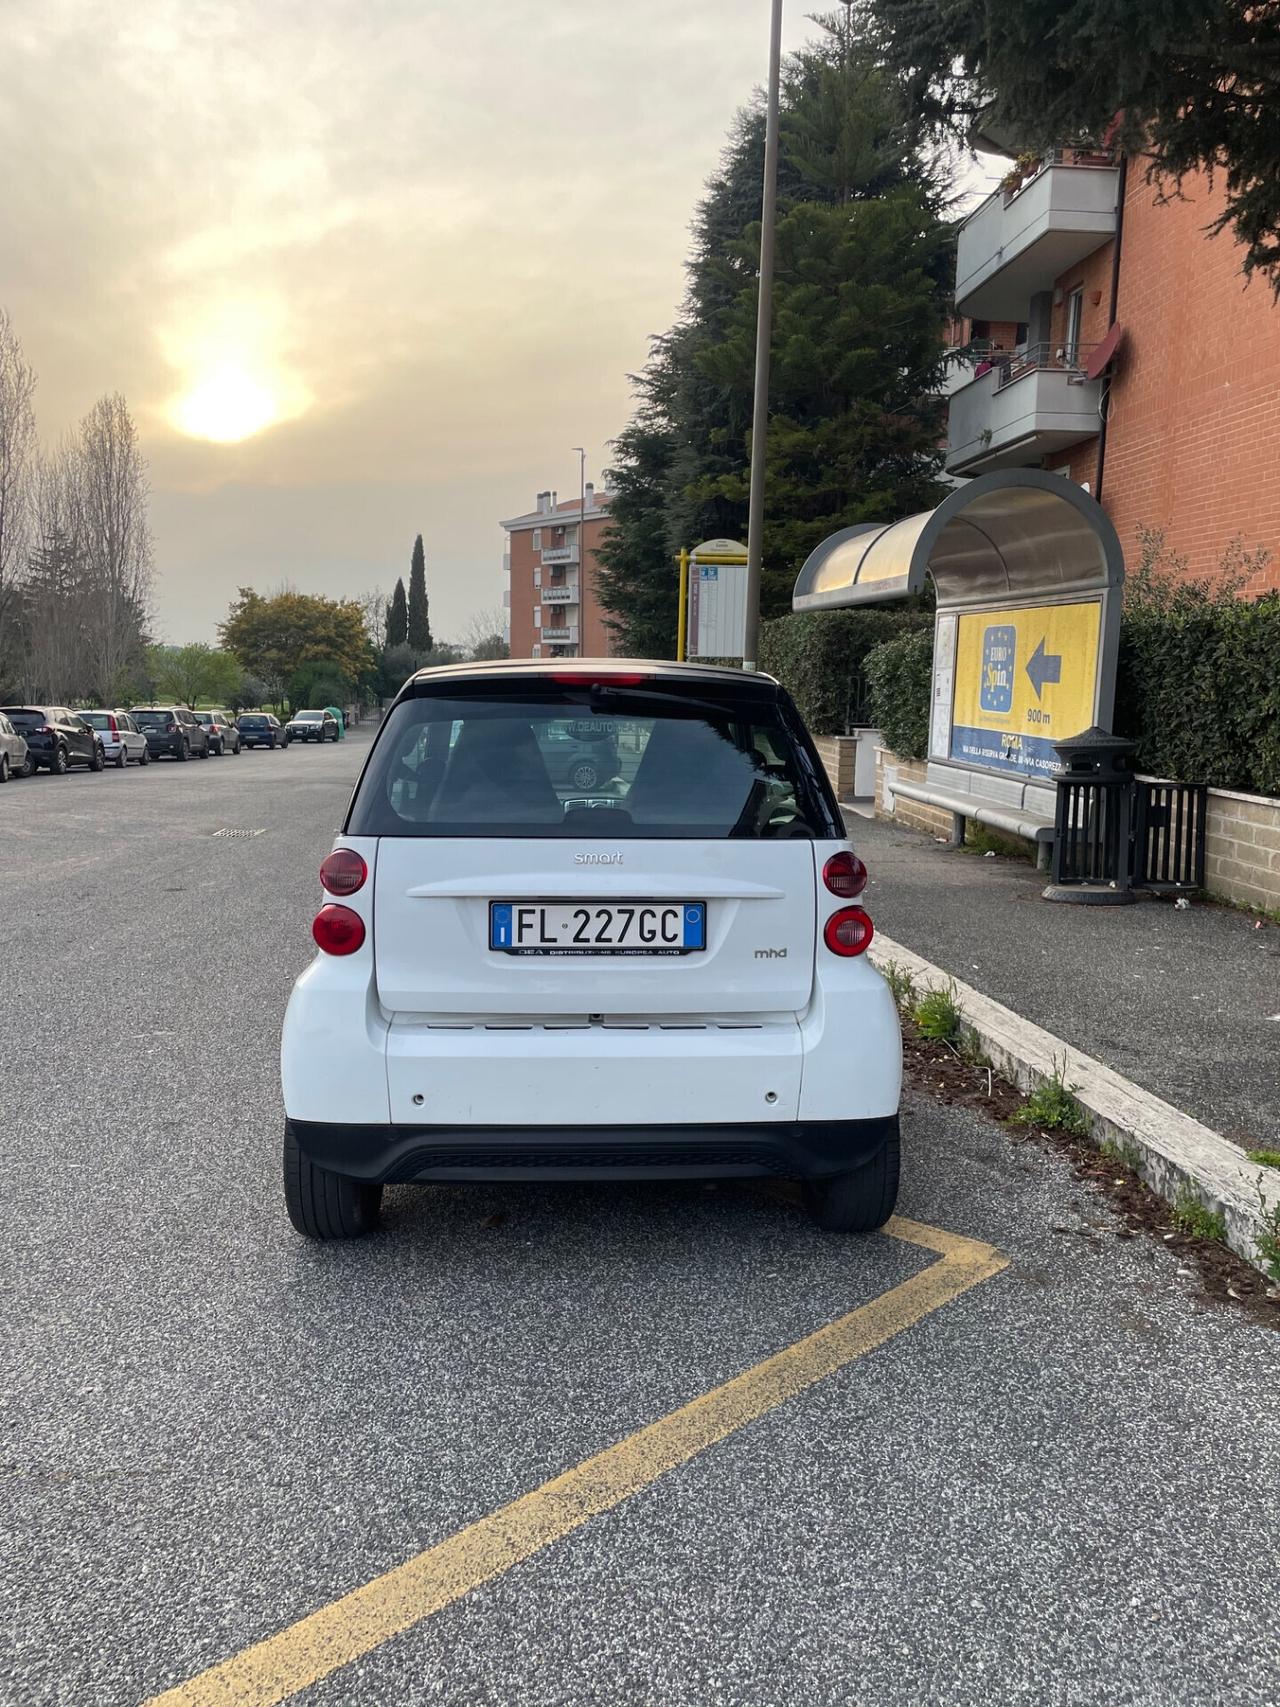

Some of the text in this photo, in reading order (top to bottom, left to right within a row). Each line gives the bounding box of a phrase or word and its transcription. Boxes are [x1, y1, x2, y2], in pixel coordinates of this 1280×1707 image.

[990, 646, 1007, 661] EURO
[986, 662, 1007, 692] Spin
[1027, 708, 1051, 724] 900 m
[574, 851, 623, 865] smart
[517, 908, 558, 943] FL
[572, 908, 679, 943] 227GC
[754, 948, 787, 959] mhd
